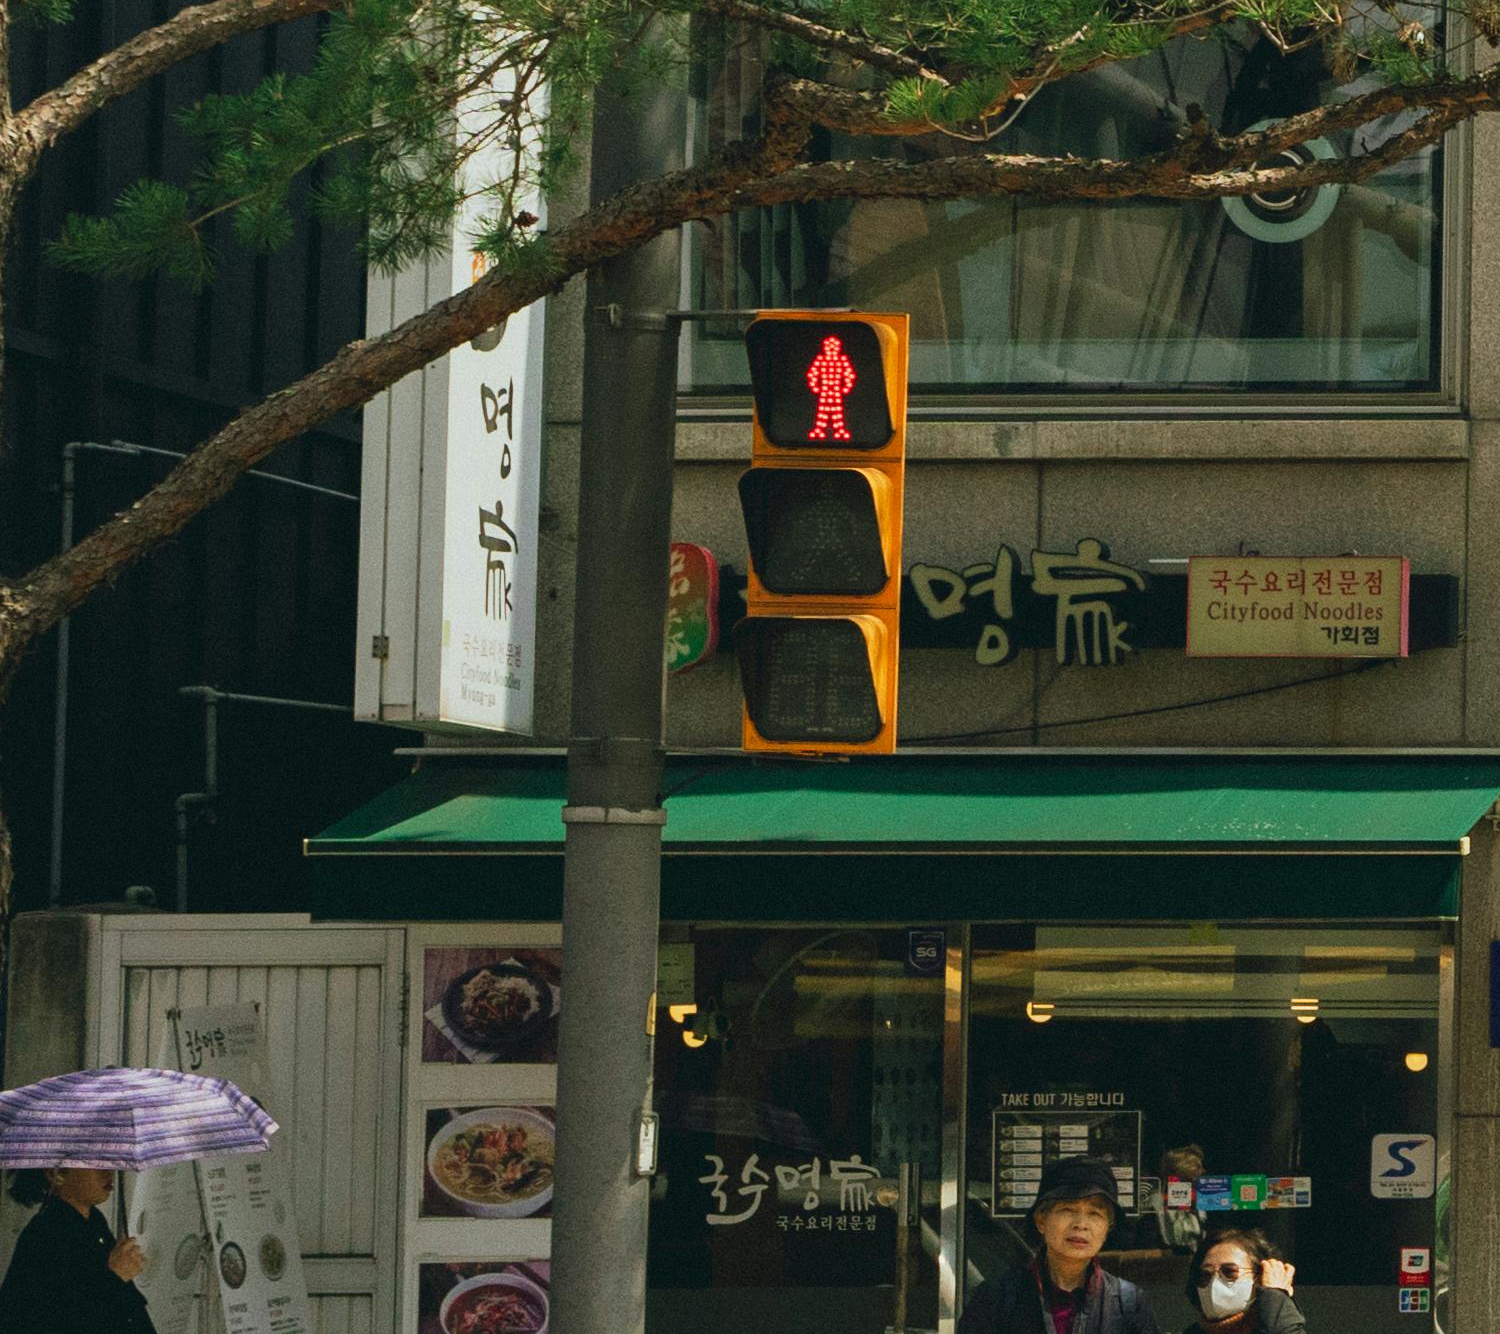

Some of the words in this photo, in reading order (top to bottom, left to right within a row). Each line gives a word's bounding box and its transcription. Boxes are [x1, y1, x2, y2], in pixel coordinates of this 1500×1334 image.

[1208, 567, 1384, 597] 국수요리전문점
[1208, 601, 1294, 623] Cityfood
[1303, 601, 1384, 621] Noodles
[1319, 625, 1381, 646] 가회점
[916, 946, 937, 958] SG
[1001, 1092, 1031, 1107] TAKE
[1033, 1092, 1057, 1107] OUT
[1060, 1091, 1126, 1107] 가능합니다
[774, 1213, 878, 1232] 국수요리전문점
